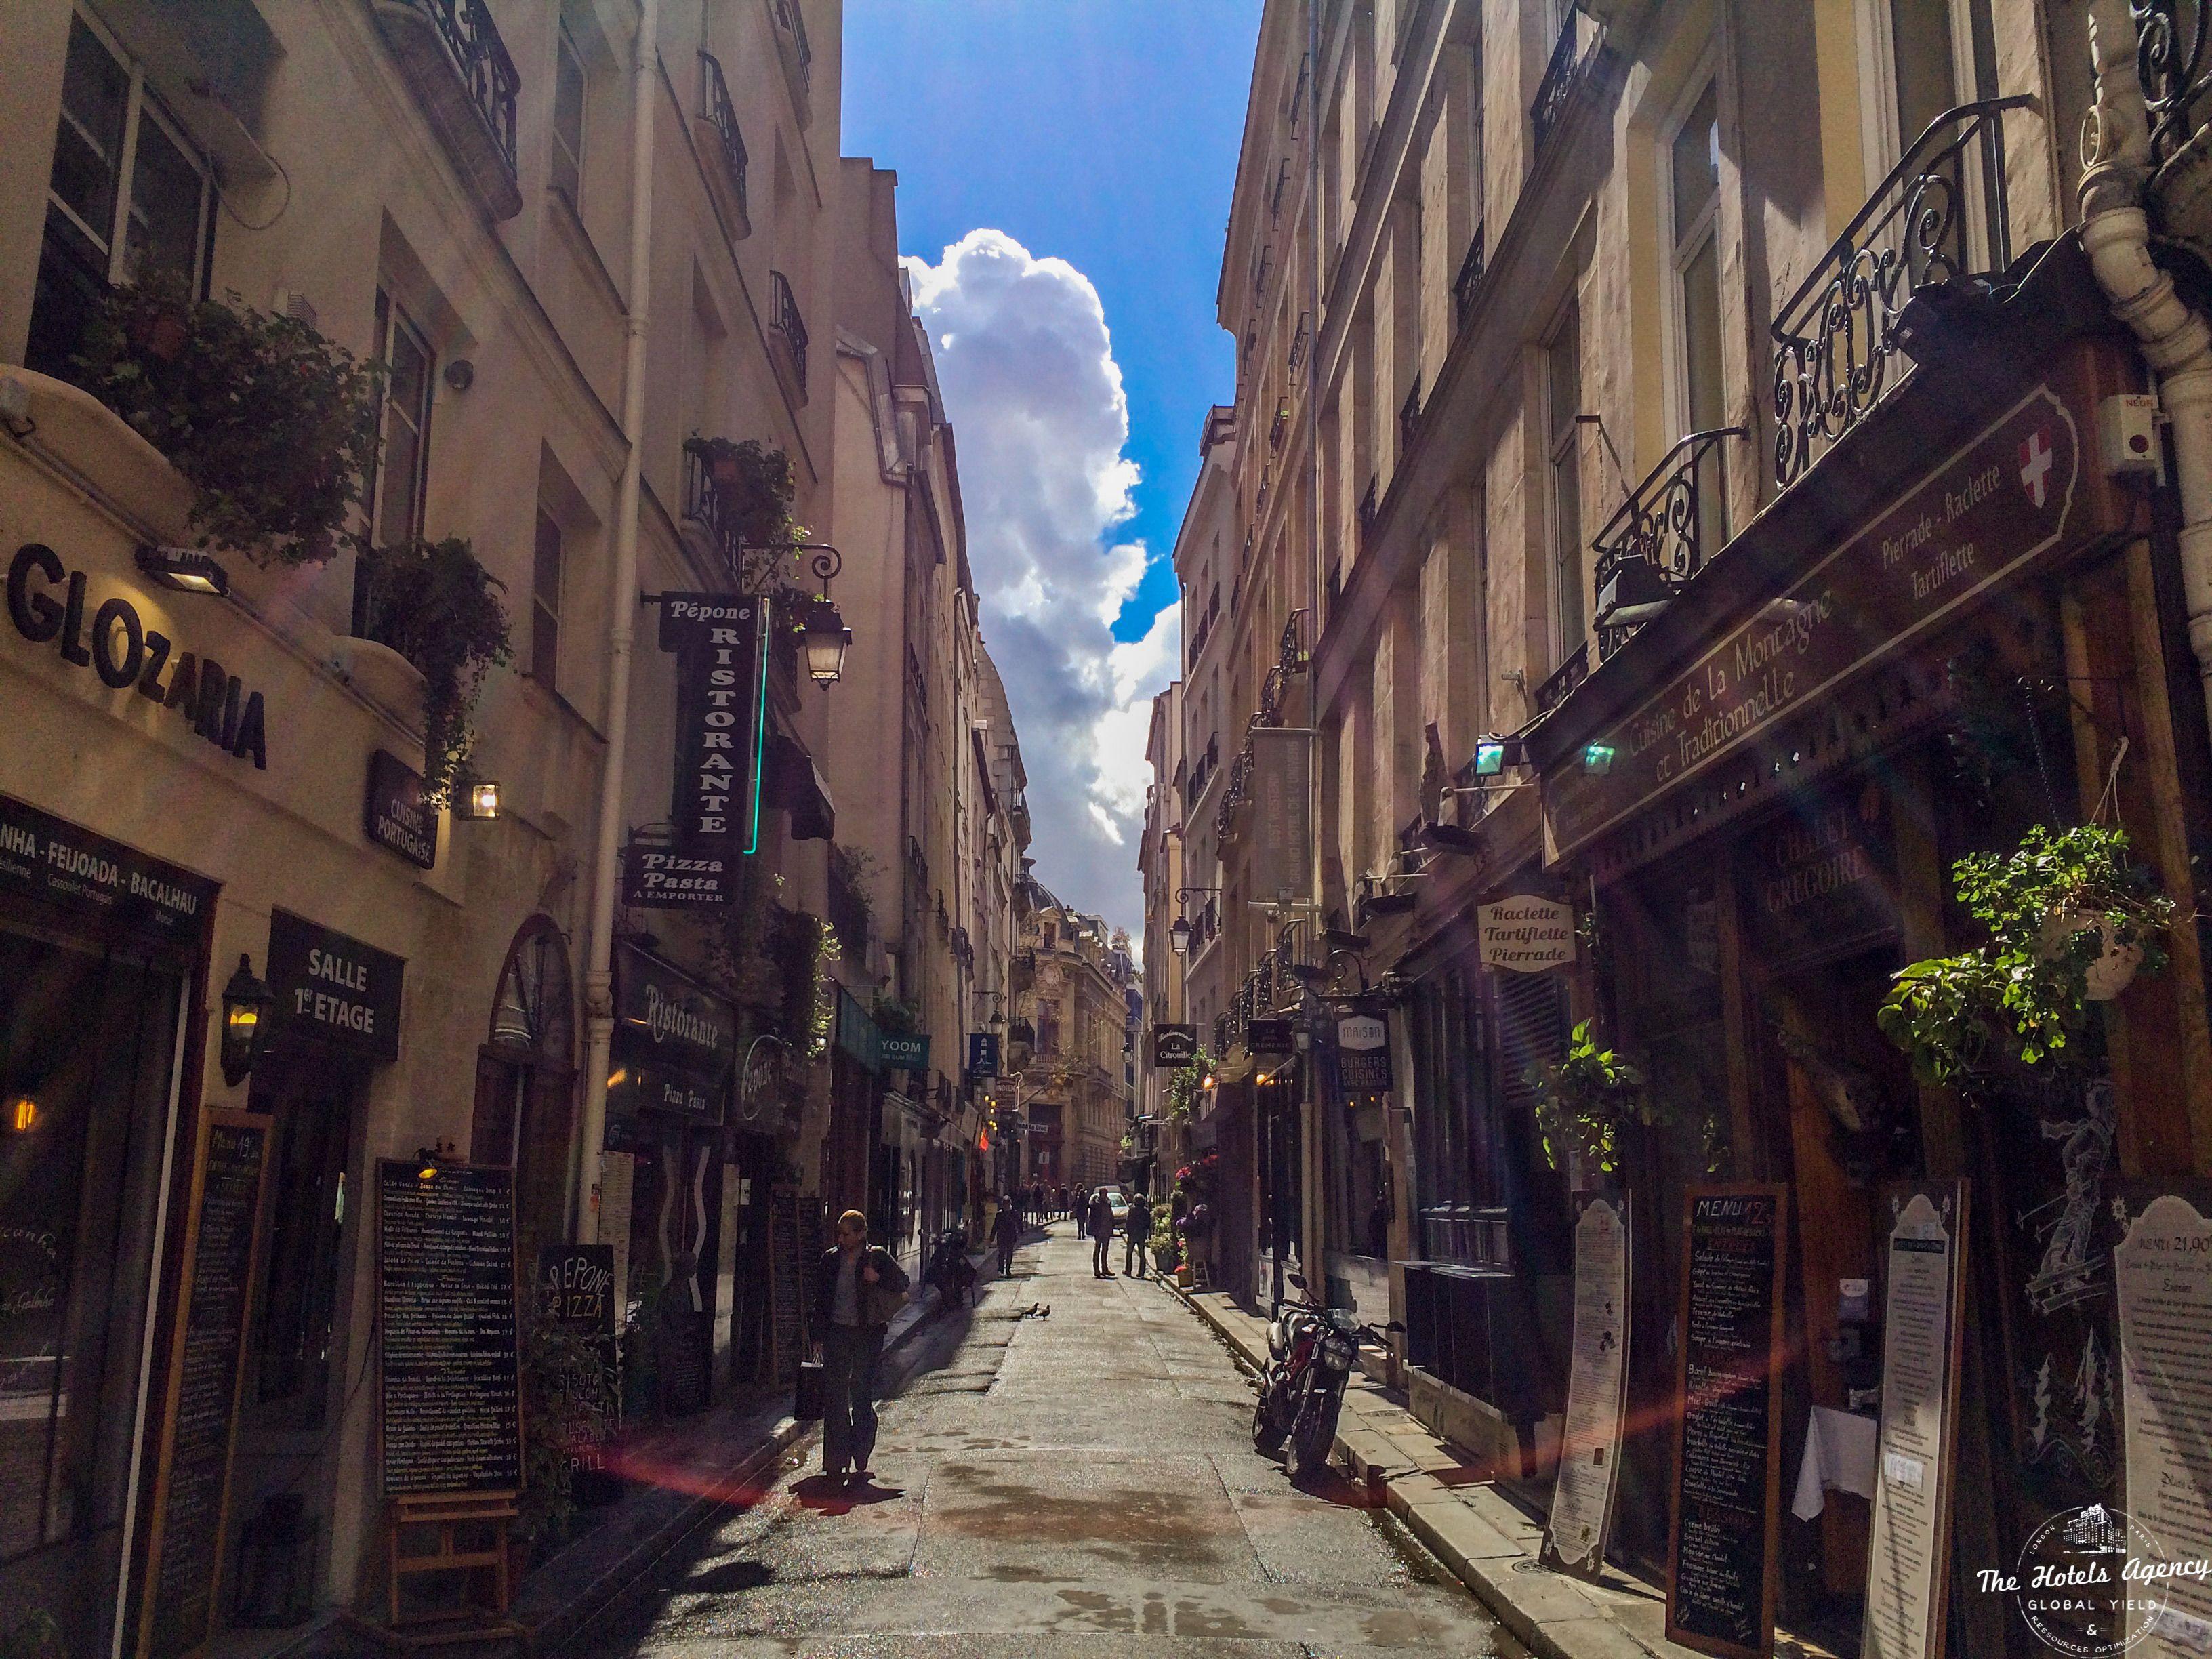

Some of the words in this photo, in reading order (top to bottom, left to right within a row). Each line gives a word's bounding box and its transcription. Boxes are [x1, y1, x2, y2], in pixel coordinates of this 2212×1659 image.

[1882, 514, 1932, 570] Pierrade
[1944, 464, 2001, 522] Raclette
[1911, 541, 1975, 601] Tartiflette
[670, 600, 751, 623] Pépone
[7, 543, 267, 771] GLOZARIA
[1628, 705, 1675, 757] Cuisine
[1683, 685, 1702, 721] de
[1708, 665, 1726, 706] La
[1735, 587, 1832, 676] Montagne
[699, 628, 741, 834] RISTORANTE
[1656, 759, 1669, 785] et
[1676, 668, 1795, 768] Traditionnelle
[1286, 797, 1300, 811] DE
[642, 853, 724, 874] Pizza
[1288, 848, 1301, 884] GRAND
[47, 840, 119, 888] FEIJOADA
[130, 872, 198, 916] BACALHAU
[643, 872, 720, 891] Pasta
[633, 890, 643, 899] A
[647, 891, 724, 902] EMPORTER
[1490, 906, 1560, 920] Raclette
[1483, 926, 1569, 945] Tartiflette
[1489, 947, 1566, 962] Pierrade
[308, 947, 368, 993] SALLE
[314, 994, 375, 1035] ETAGE
[646, 983, 719, 1050] Ristorante
[1343, 1026, 1380, 1038] MAISON
[881, 1040, 921, 1052] YOOM
[1160, 1050, 1192, 1059] Citrouille
[1340, 1057, 1387, 1069] BURGERS
[1696, 1200, 1743, 1217] MENU
[549, 1256, 614, 1298] PEPONE
[548, 1295, 602, 1319] PIZZA
